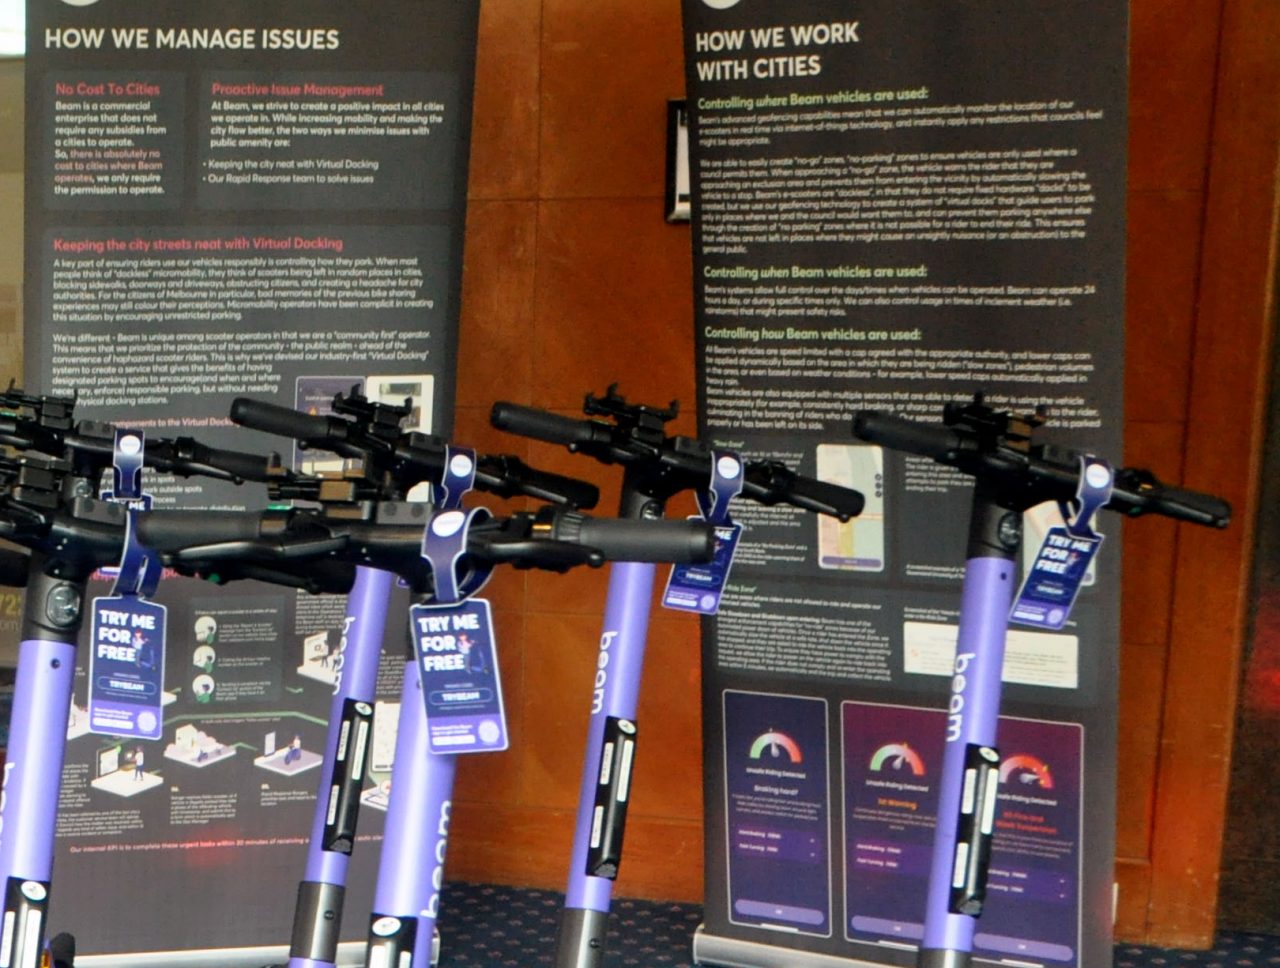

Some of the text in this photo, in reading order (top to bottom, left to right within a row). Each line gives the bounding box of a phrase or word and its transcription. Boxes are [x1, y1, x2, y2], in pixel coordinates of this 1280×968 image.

[45, 28, 339, 49] HOW WE MANAGE ISSUES
[696, 21, 859, 51] HOW WE WORK
[696, 54, 821, 80] WITH CITIES
[55, 82, 160, 96] No Cost To Cities
[211, 82, 383, 98] Proactive Issue Management
[698, 86, 928, 111] Controlling where Beam vehicles are used:
[207, 173, 374, 184] Our Rapid Response team to solve issues
[53, 236, 343, 253] Keeping the city streets neat with Virtual Docking
[704, 264, 927, 281] Controlling when Beam vehicles are used:
[704, 326, 921, 342] Controlling how Beam vehicles are used:
[1048, 534, 1092, 552] TRY ME
[1041, 547, 1069, 561] FOR
[1035, 559, 1067, 574] FREE
[99, 609, 156, 630] TRY ME
[418, 613, 479, 633] TRY ME
[98, 626, 131, 644] FOR
[421, 635, 457, 652] FOR
[97, 644, 136, 662] FREE
[424, 655, 465, 672] FREE
[592, 631, 618, 714] beam
[946, 652, 976, 742] beam
